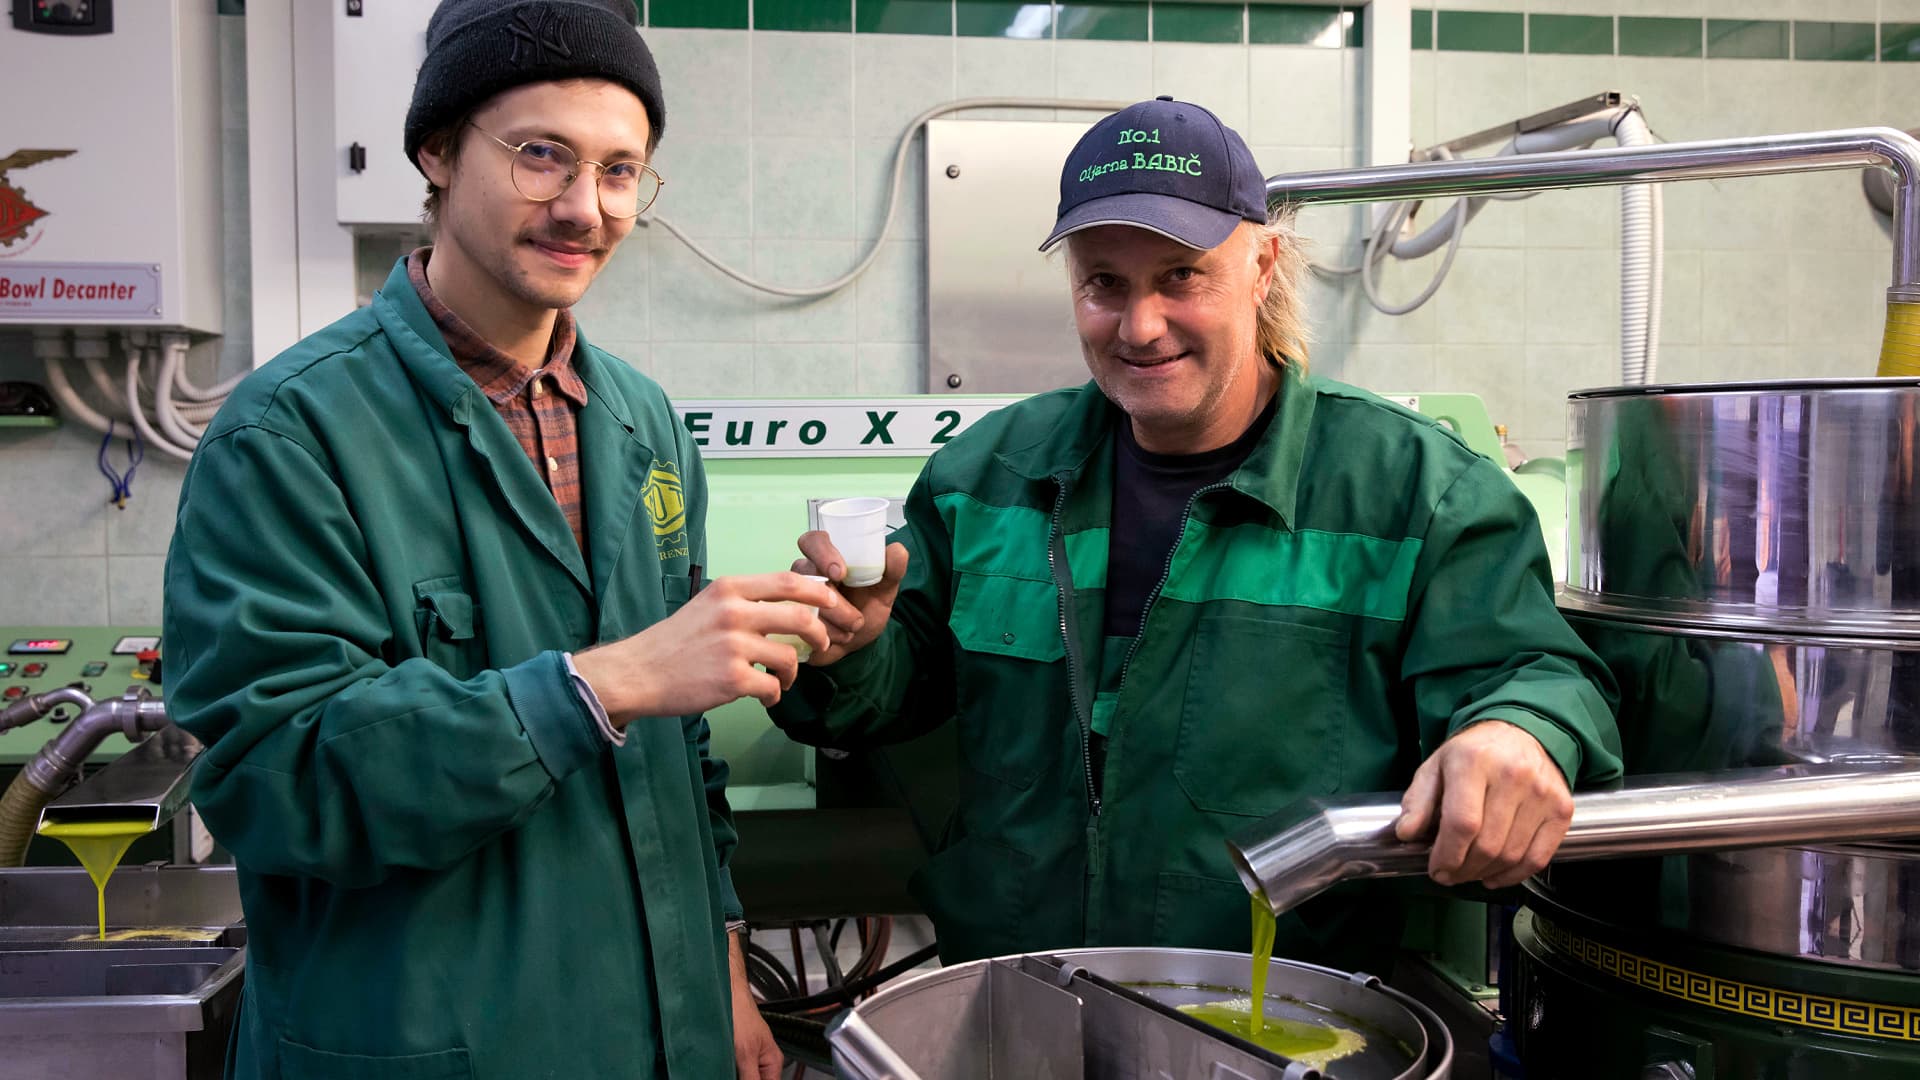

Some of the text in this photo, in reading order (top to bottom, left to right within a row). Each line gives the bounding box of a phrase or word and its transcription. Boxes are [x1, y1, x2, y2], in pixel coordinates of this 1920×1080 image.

[1118, 128, 1161, 145] No.1
[1131, 152, 1202, 176] BABIČ
[0, 277, 137, 300] Bowl Decanter
[684, 412, 827, 446] Euro
[860, 411, 898, 445] X
